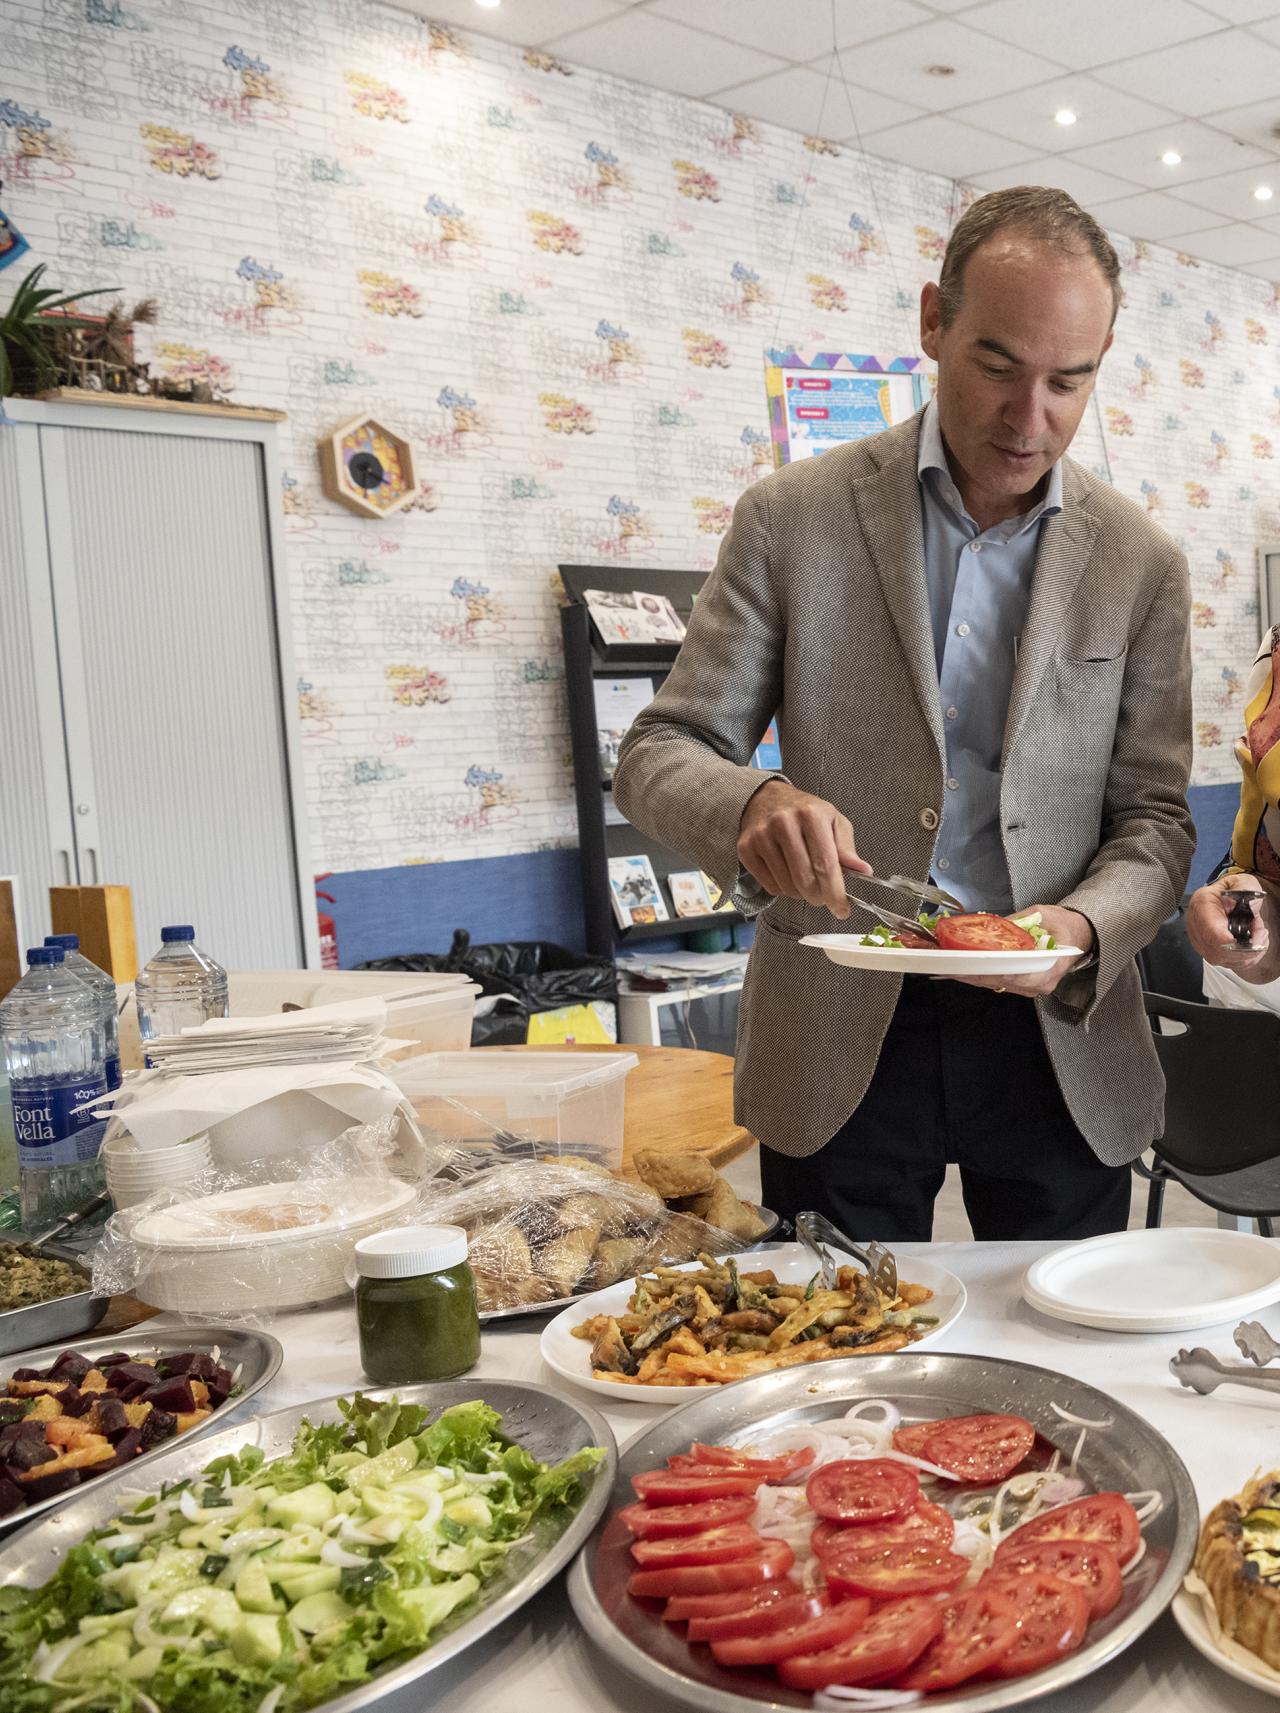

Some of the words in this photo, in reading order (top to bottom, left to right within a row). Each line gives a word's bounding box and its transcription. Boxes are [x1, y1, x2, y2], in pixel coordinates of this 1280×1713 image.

[74, 1089, 96, 1100] 100%
[14, 1105, 53, 1122] Font
[16, 1123, 56, 1140] Vella
